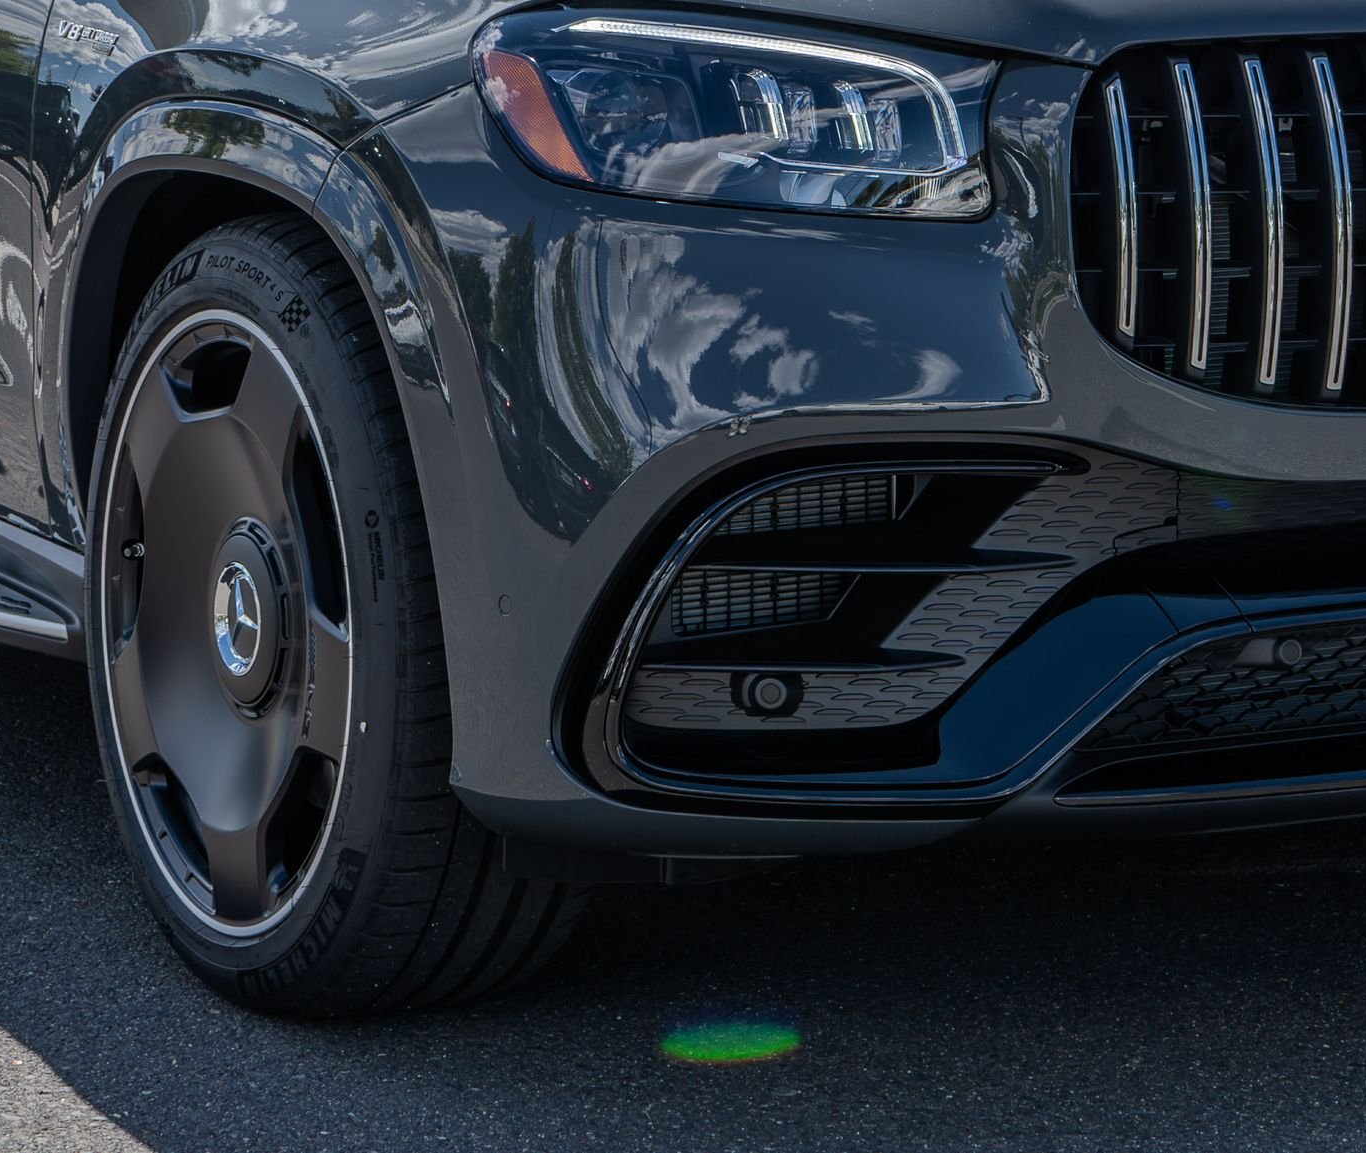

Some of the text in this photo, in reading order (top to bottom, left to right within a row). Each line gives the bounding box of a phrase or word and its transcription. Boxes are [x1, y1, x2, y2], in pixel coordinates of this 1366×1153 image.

[58, 19, 83, 42] V8
[206, 253, 236, 269] PILOT
[235, 259, 271, 289] SPORT
[269, 282, 276, 292] 4
[275, 289, 285, 303] S
